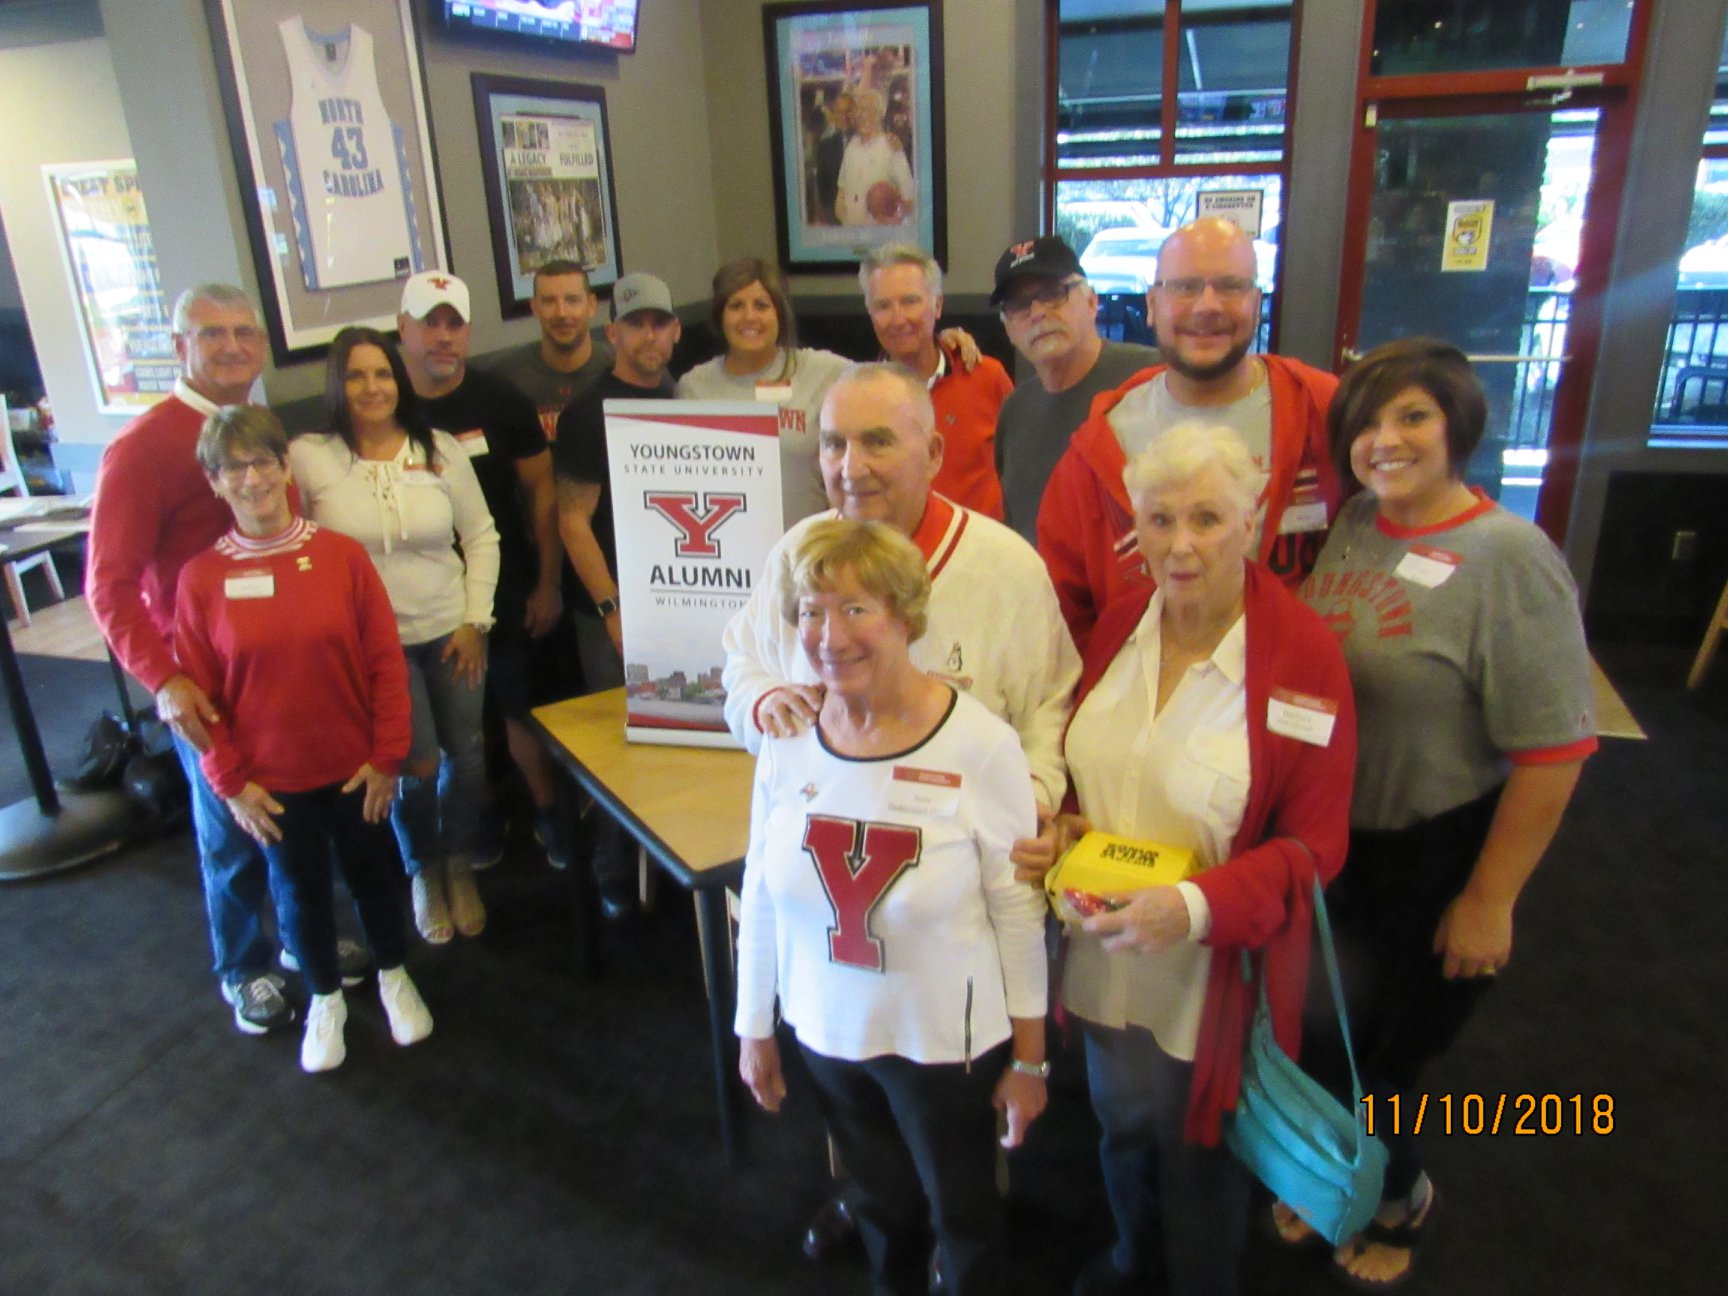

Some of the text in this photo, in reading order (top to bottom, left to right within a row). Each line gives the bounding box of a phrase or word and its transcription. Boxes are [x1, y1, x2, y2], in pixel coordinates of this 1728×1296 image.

[318, 97, 364, 125] NORTH
[331, 126, 368, 170] 43
[322, 168, 385, 198] CAROLINA
[629, 444, 756, 461] YOUNGSTOWN
[624, 463, 764, 477] STATE UNIVERSITY
[643, 490, 747, 559] Y
[650, 563, 752, 588] ALUMNI
[801, 813, 923, 975] Y
